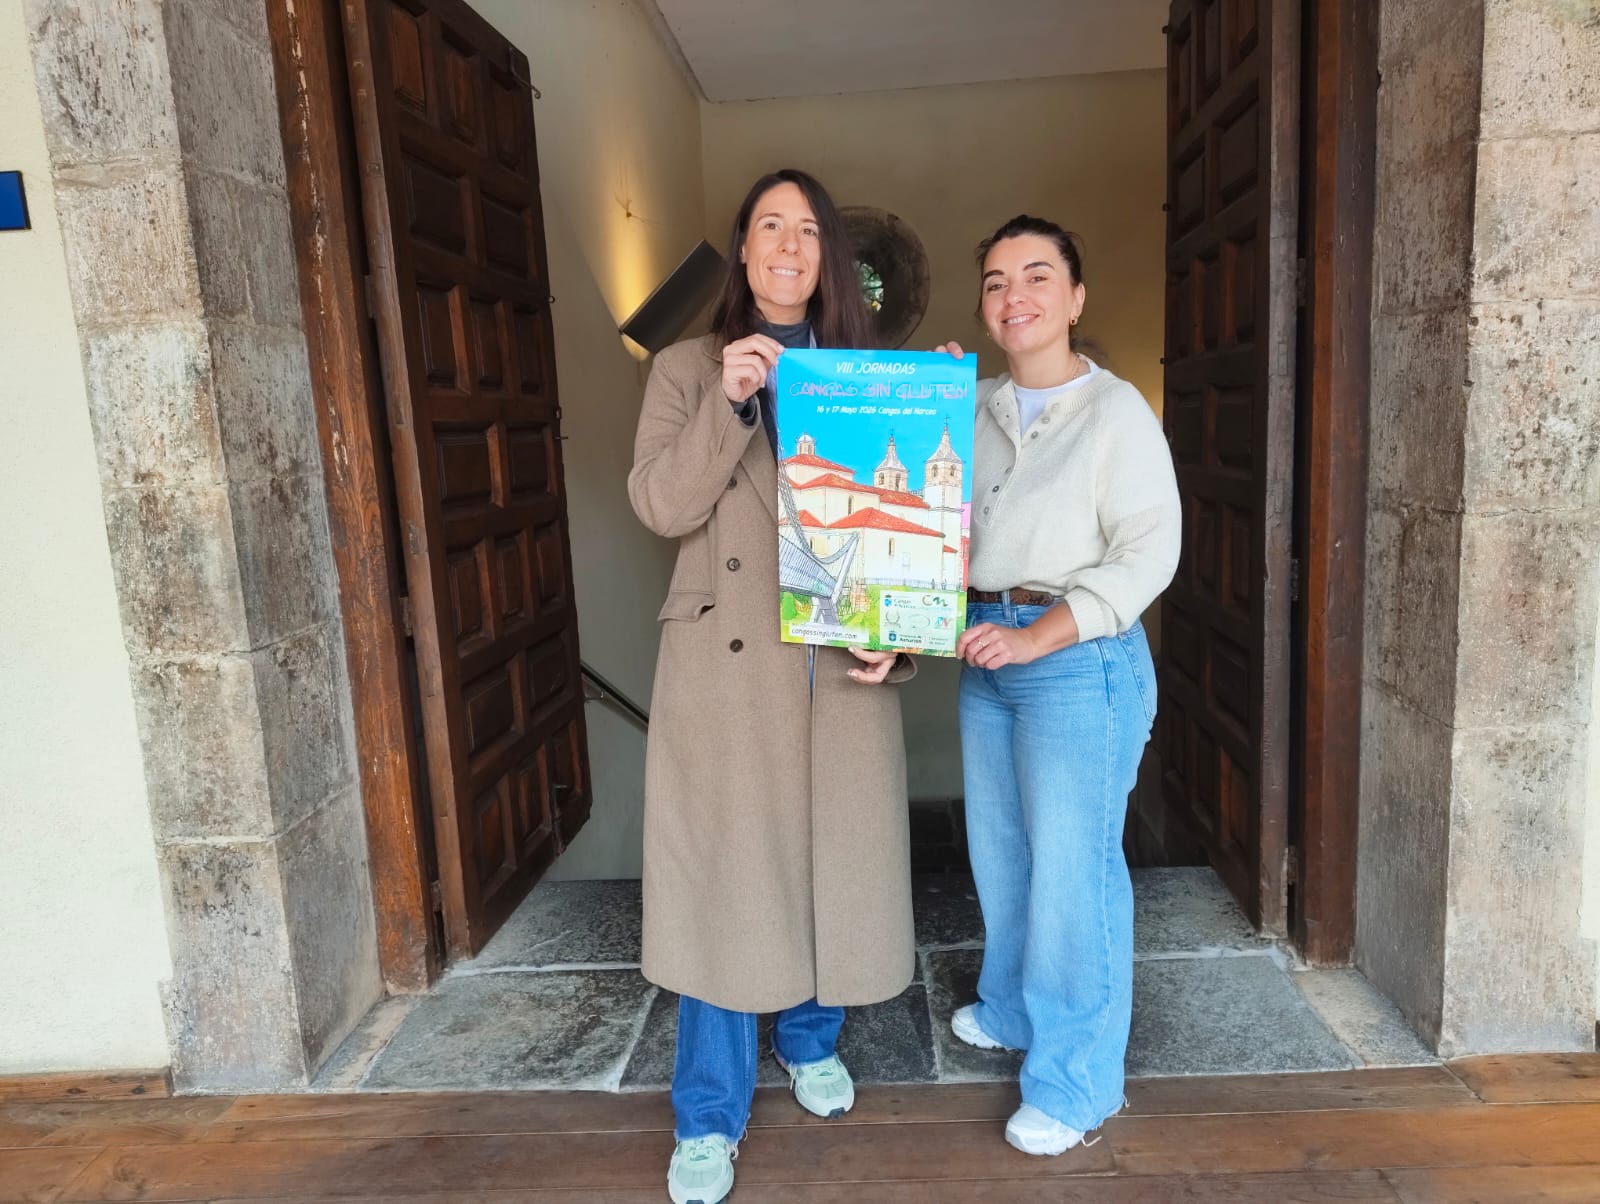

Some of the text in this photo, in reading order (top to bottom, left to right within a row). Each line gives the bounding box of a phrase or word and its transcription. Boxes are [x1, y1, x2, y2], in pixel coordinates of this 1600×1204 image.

[836, 361, 916, 375] VIII JORNADAS
[789, 379, 968, 401] CANGAS SIN GLUTEN
[832, 405, 840, 414] 17
[841, 406, 857, 416] Mayo
[878, 406, 901, 416] Cangas
